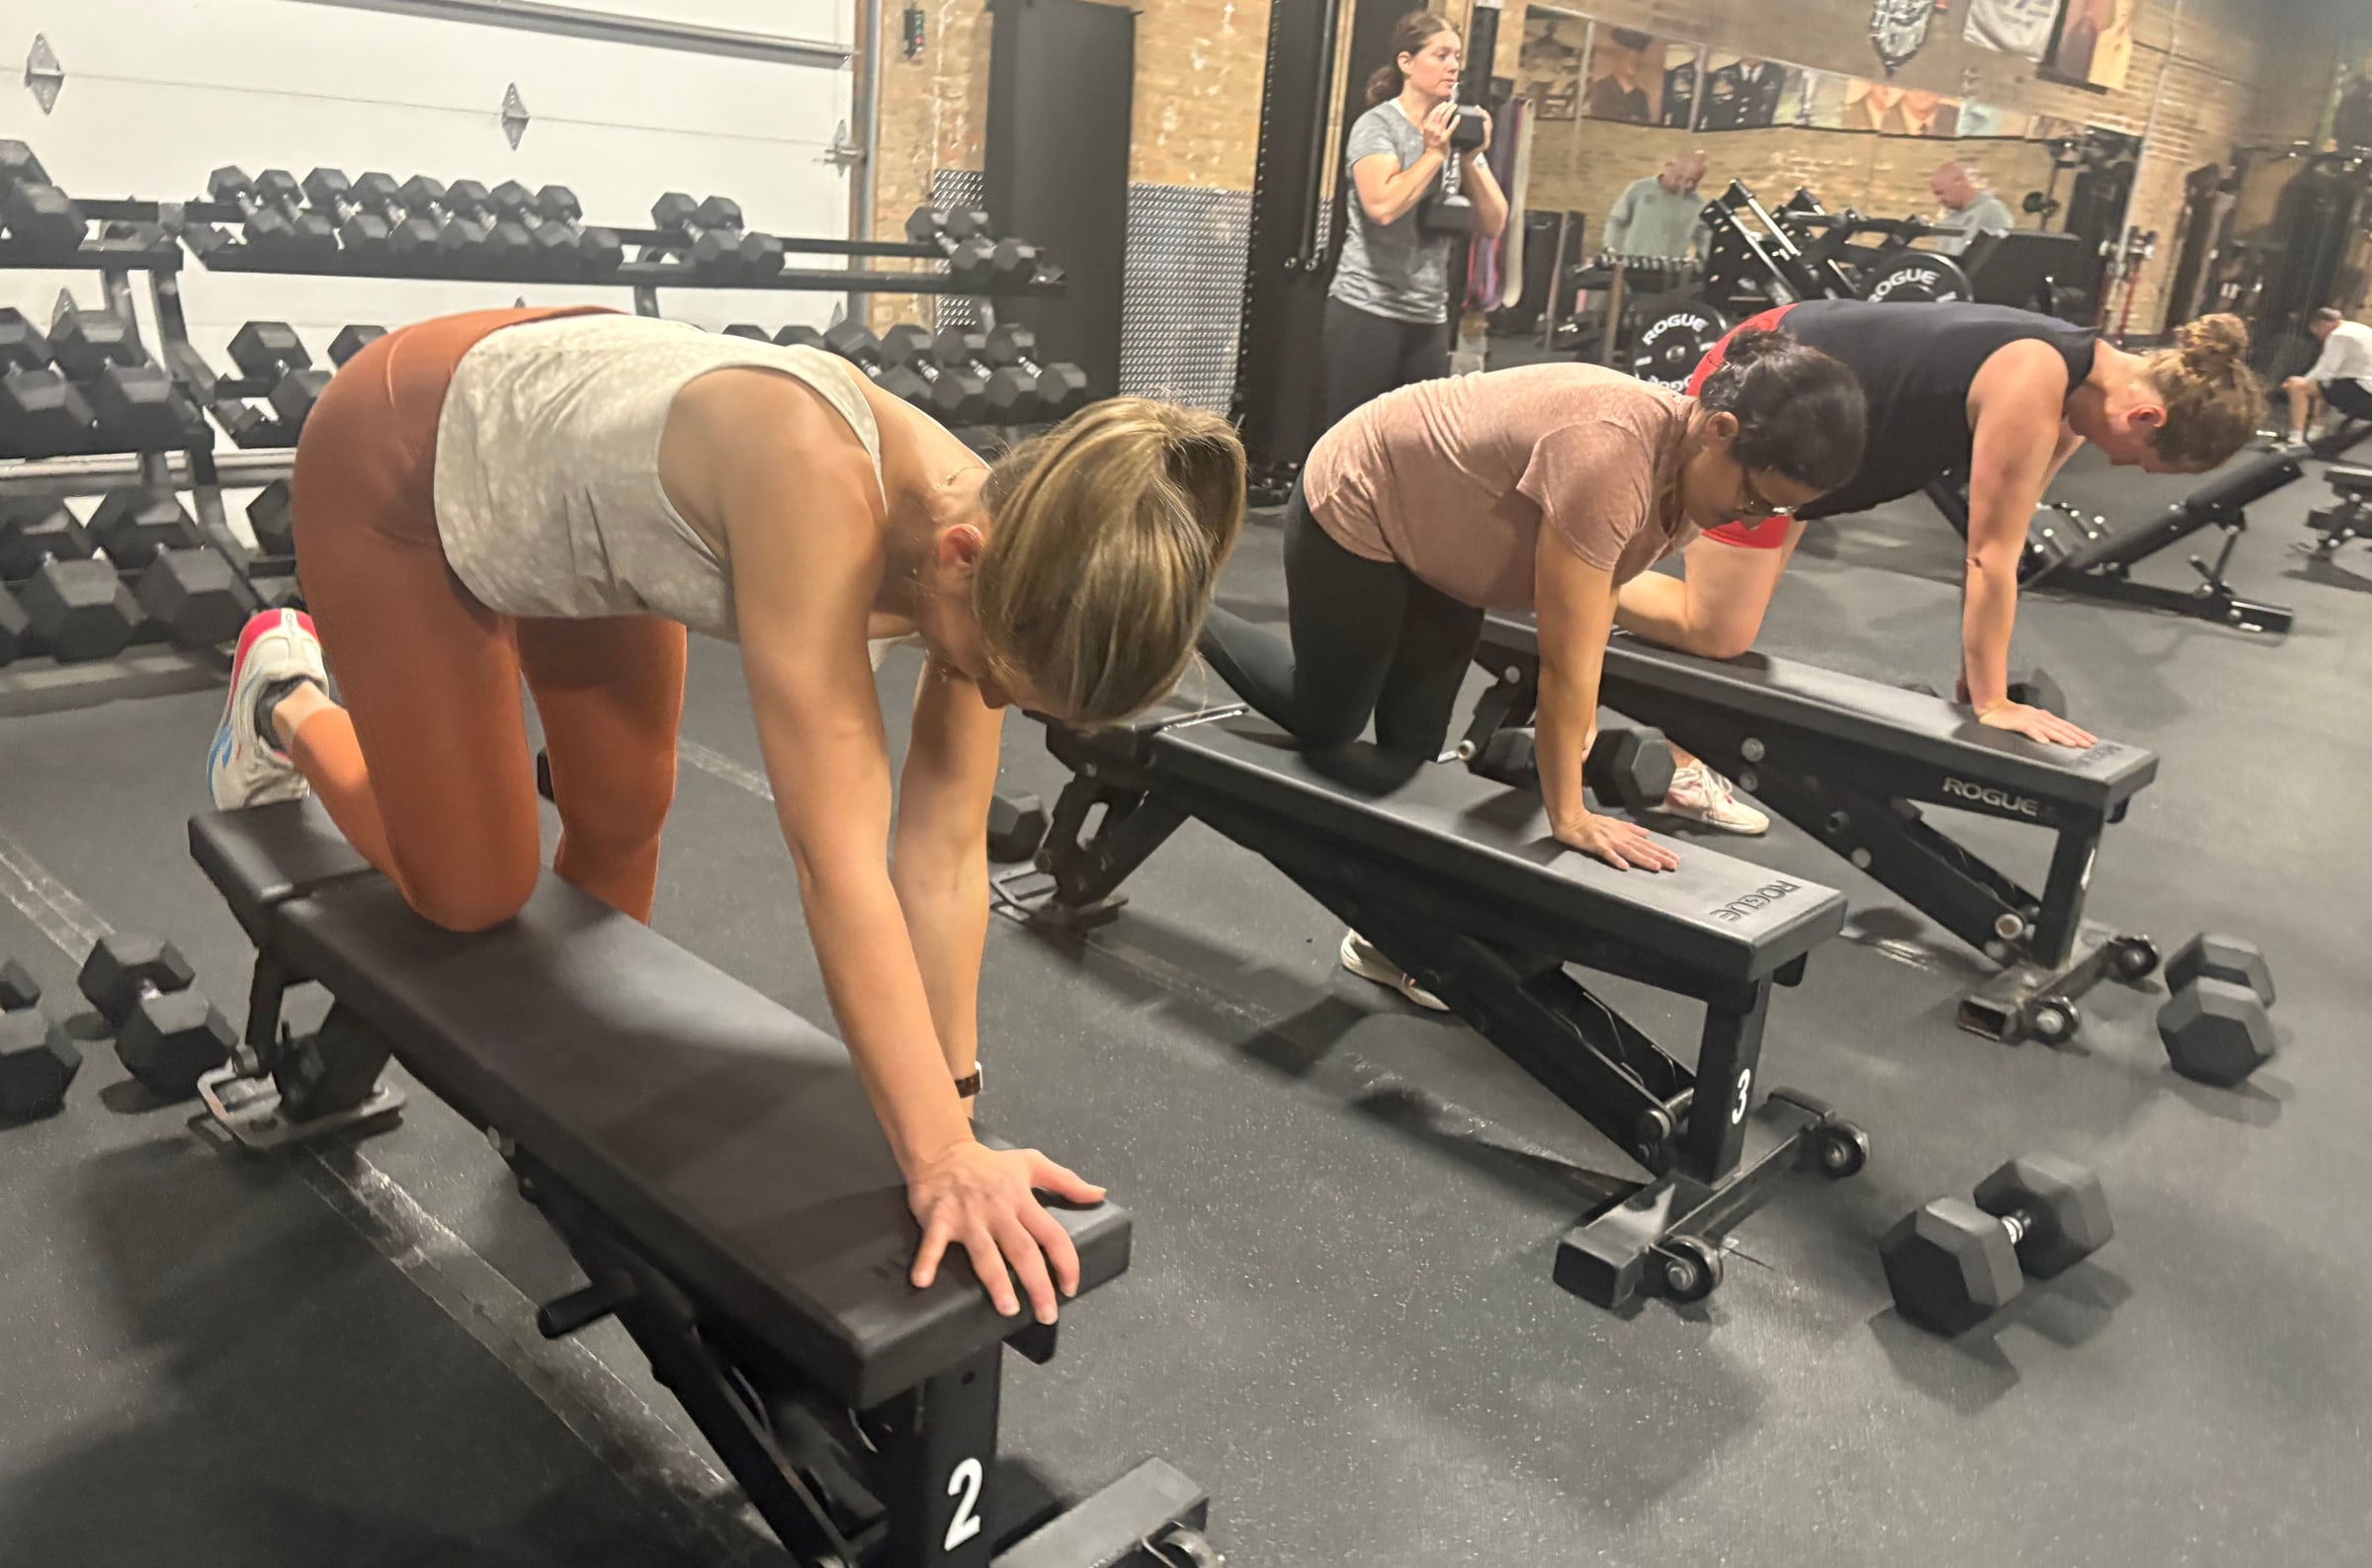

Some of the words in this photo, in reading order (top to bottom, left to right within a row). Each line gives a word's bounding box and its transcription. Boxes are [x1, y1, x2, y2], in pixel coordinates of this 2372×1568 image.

[1867, 268, 1941, 302] ROGUE
[1642, 313, 1710, 345] ROGUE
[1942, 777, 2040, 816] ROGUE
[1709, 879, 1803, 921] ROGUE
[1732, 1068, 1750, 1124] 3
[944, 1457, 983, 1551] 2
